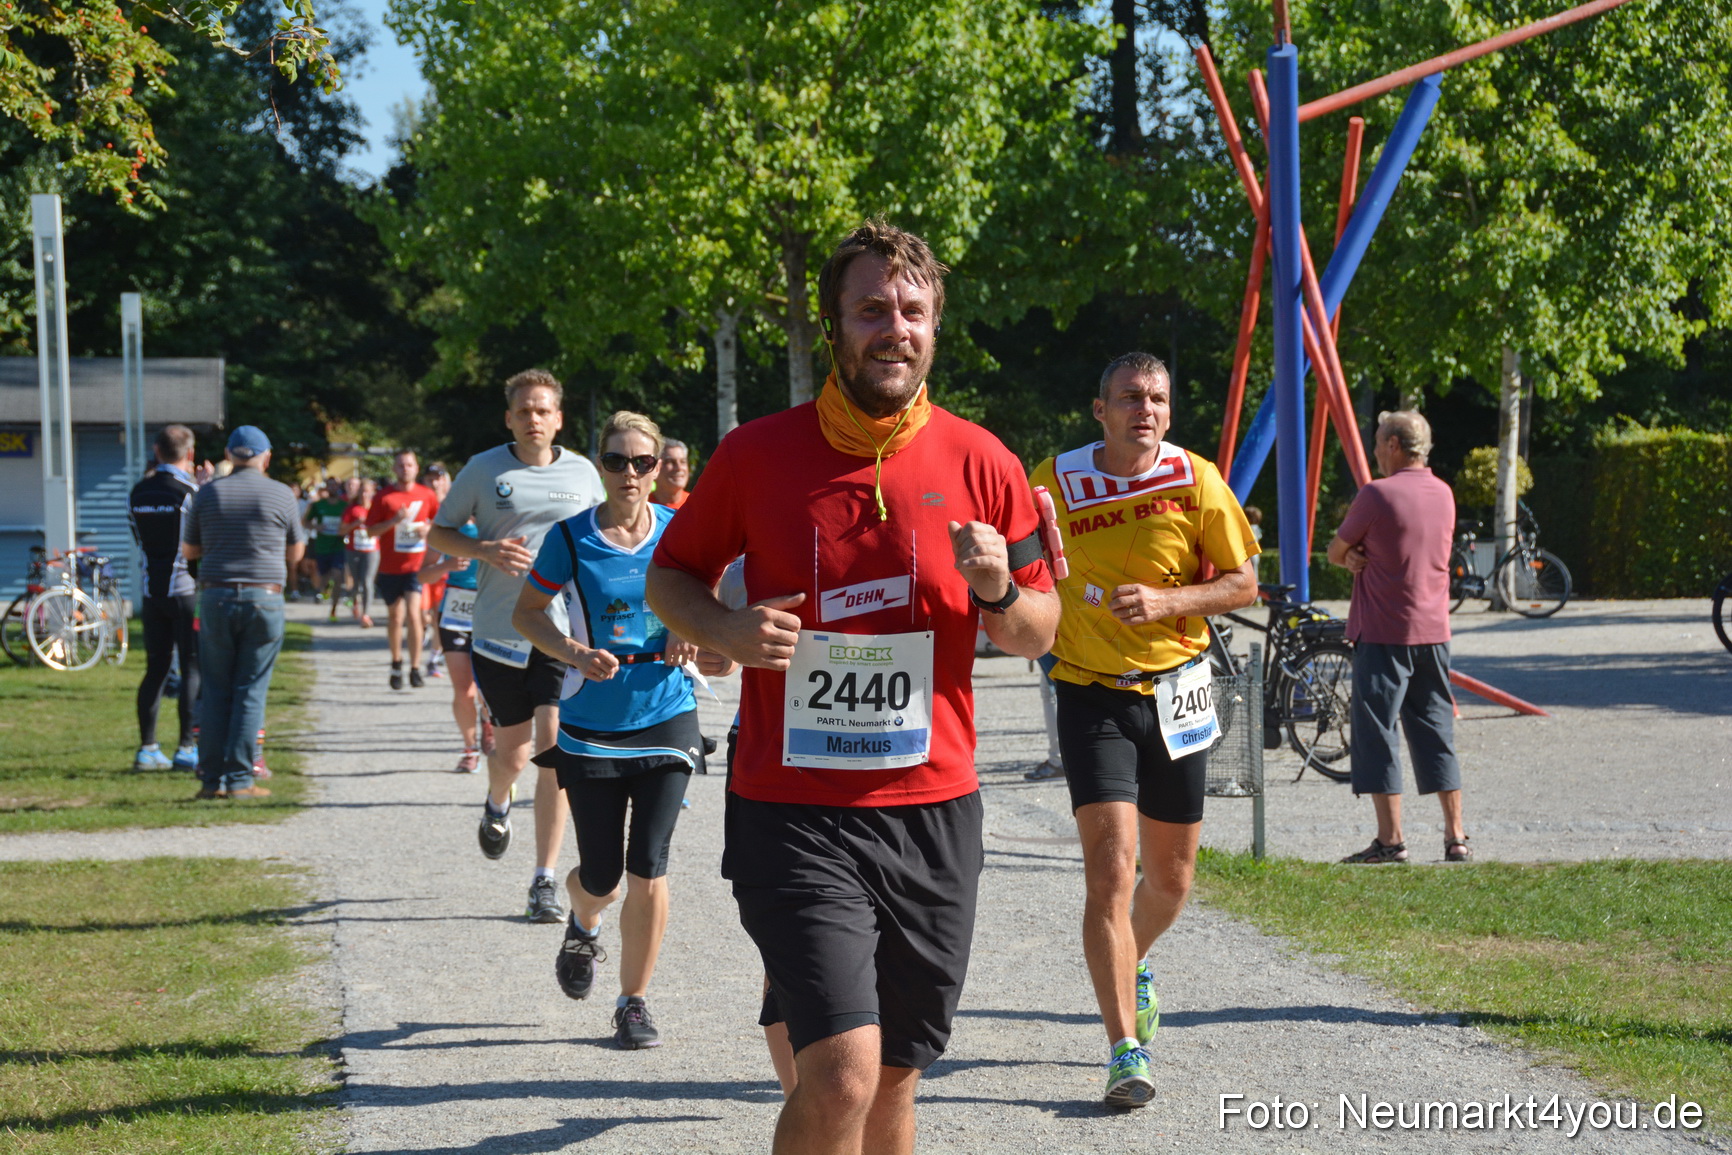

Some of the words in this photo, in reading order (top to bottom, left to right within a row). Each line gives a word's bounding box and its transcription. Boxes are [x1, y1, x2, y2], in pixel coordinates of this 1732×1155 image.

[1069, 509, 1127, 537] MAX
[1134, 496, 1199, 520] BÖGL
[845, 588, 885, 608] DEHN
[601, 612, 636, 623] Pyraser
[483, 642, 512, 659] Manfred
[829, 645, 893, 661] BOCK
[808, 670, 911, 712] 2440
[817, 717, 846, 727] PARTL
[849, 719, 891, 728] Neumarkt
[827, 736, 891, 754] Markus
